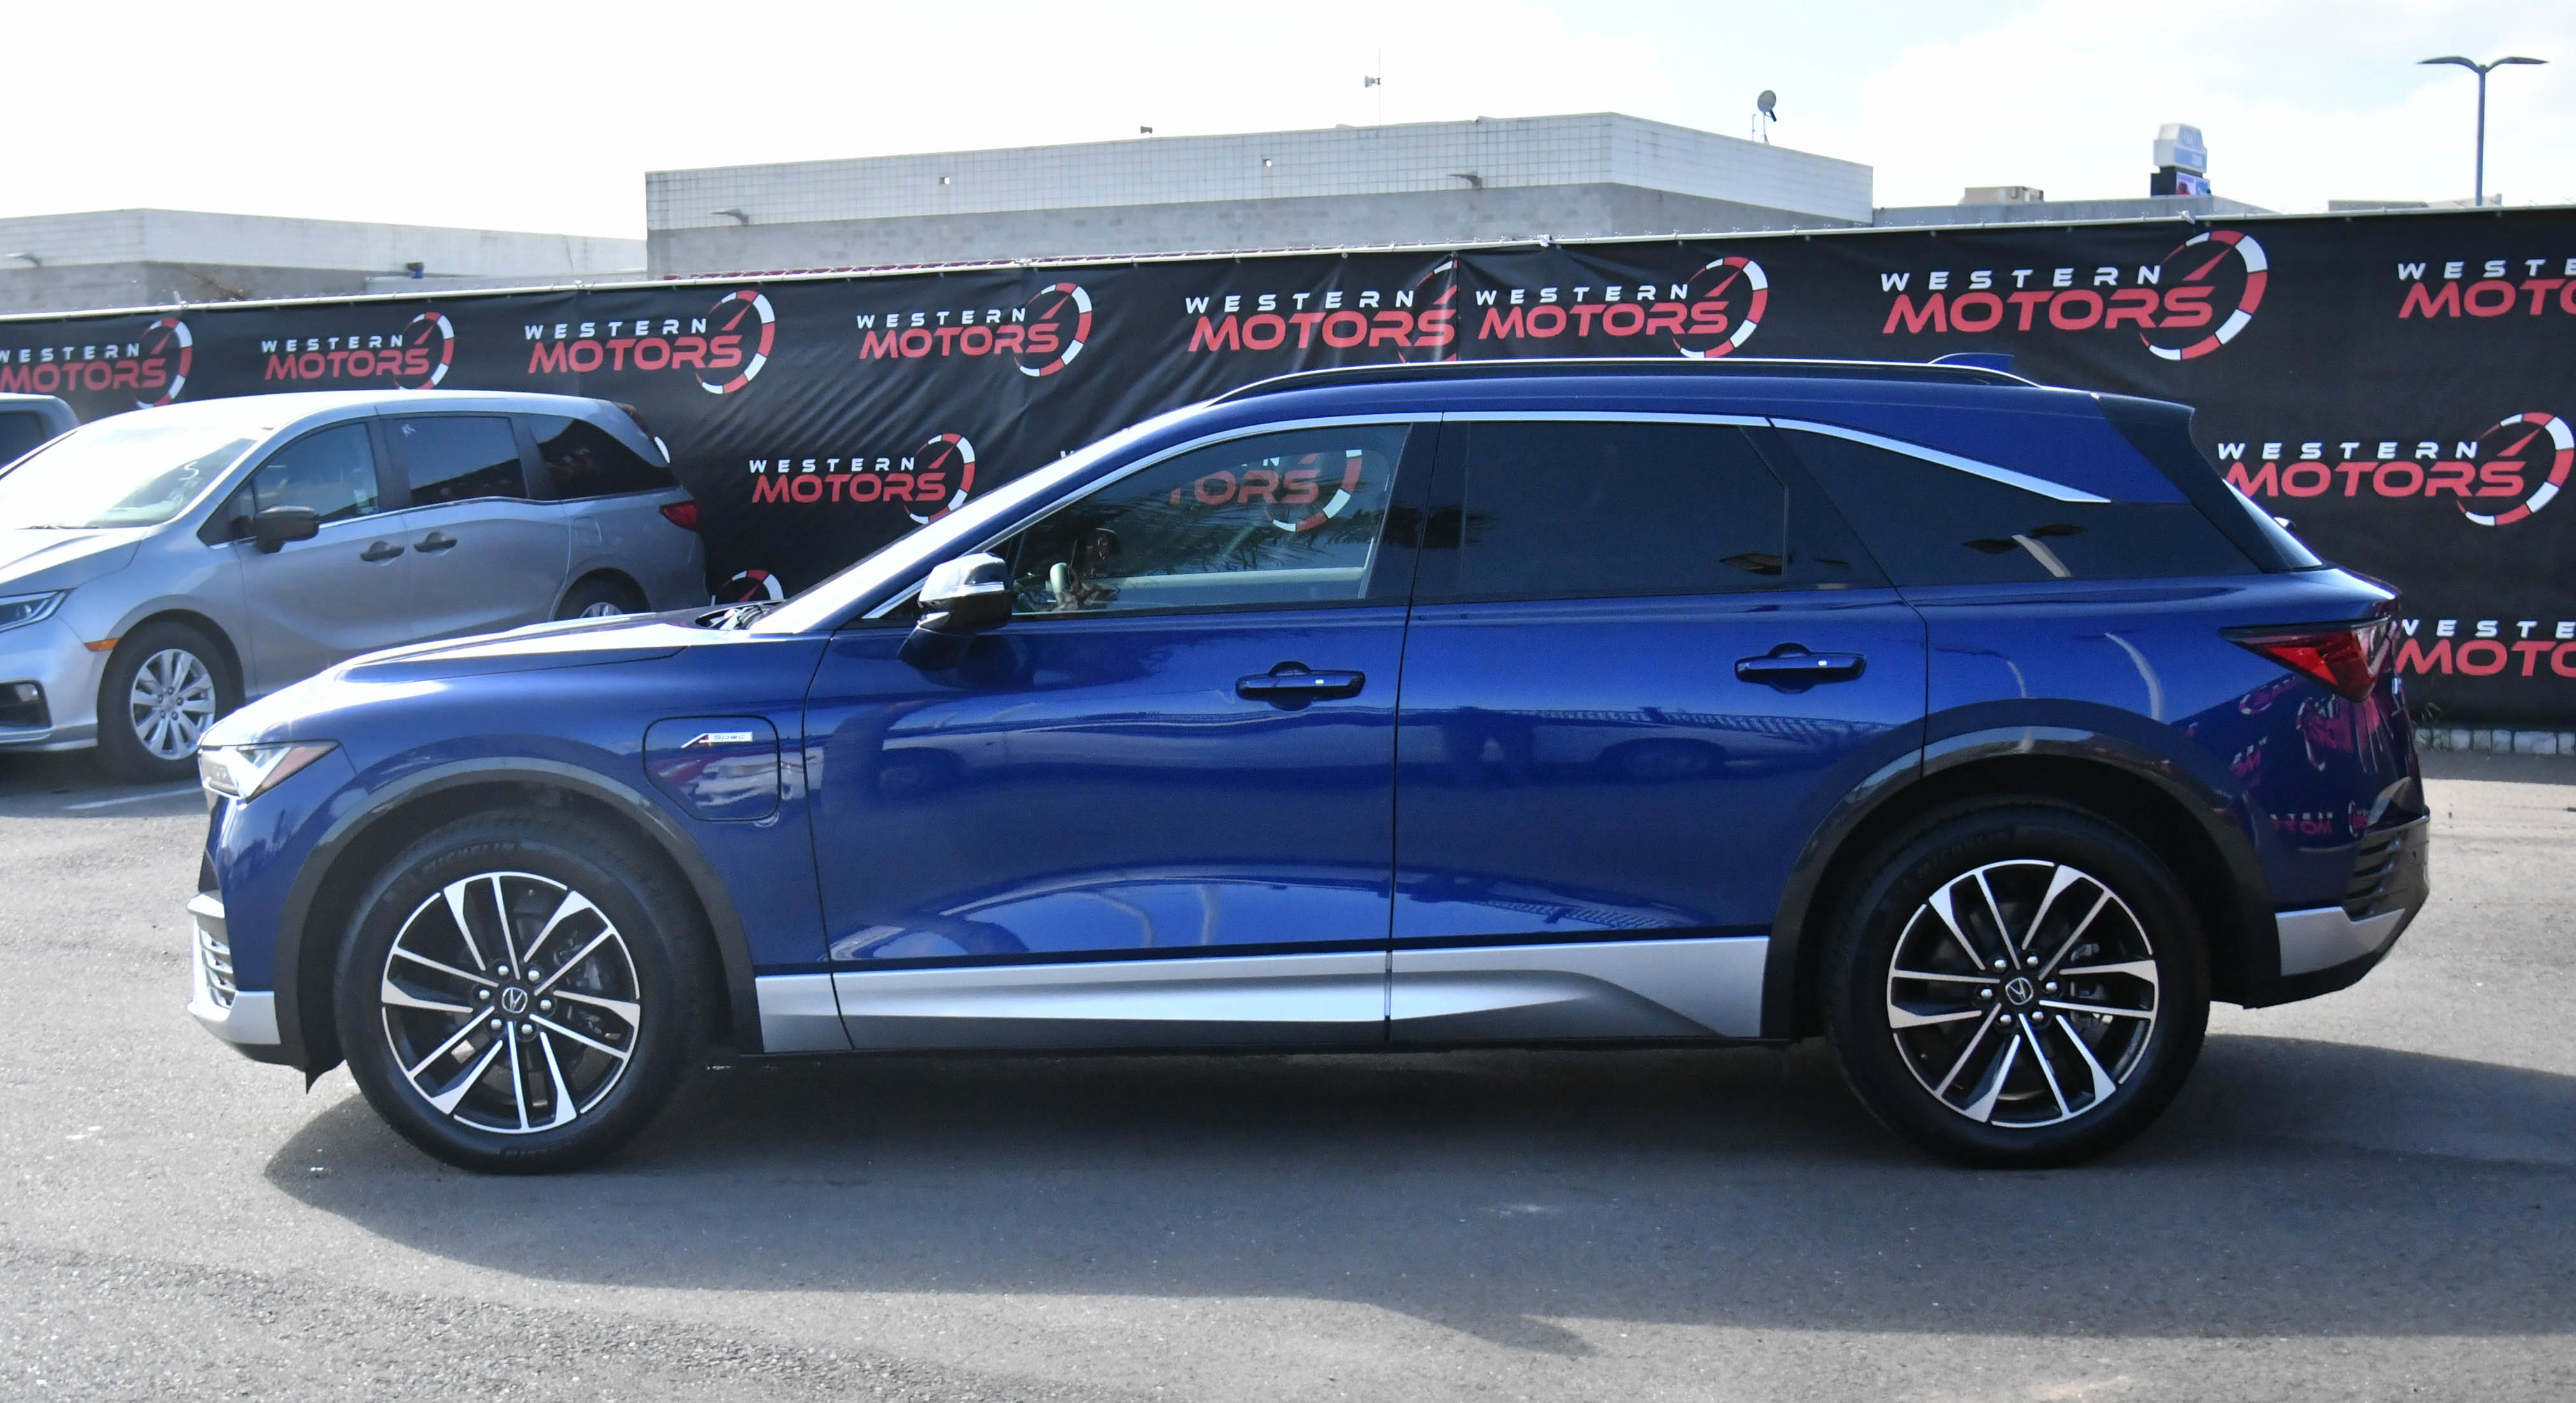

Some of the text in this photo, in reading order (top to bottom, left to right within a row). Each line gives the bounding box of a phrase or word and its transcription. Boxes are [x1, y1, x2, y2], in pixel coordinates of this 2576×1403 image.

[1880, 265, 2161, 292] WESTERN
[1185, 289, 1415, 315] WESTERN
[1475, 283, 1688, 307] WESTERN
[856, 307, 1027, 329] WESTERN
[1478, 300, 1729, 340] MOTORS
[1883, 286, 2215, 335] MOTORS
[524, 317, 707, 340] WESTERN
[859, 322, 1060, 359] MOTORS
[1188, 308, 1457, 352] MOTORS
[0, 343, 140, 363] WESTERN
[261, 334, 403, 353] WESTERN
[528, 335, 742, 374] MOTORS
[0, 358, 167, 393] MOTORS
[265, 348, 429, 380] MOTORS
[749, 456, 915, 474] WESTERN
[2217, 441, 2478, 460] WESTERN
[752, 472, 946, 503] MOTORS
[2226, 460, 2526, 498] MOTORS
